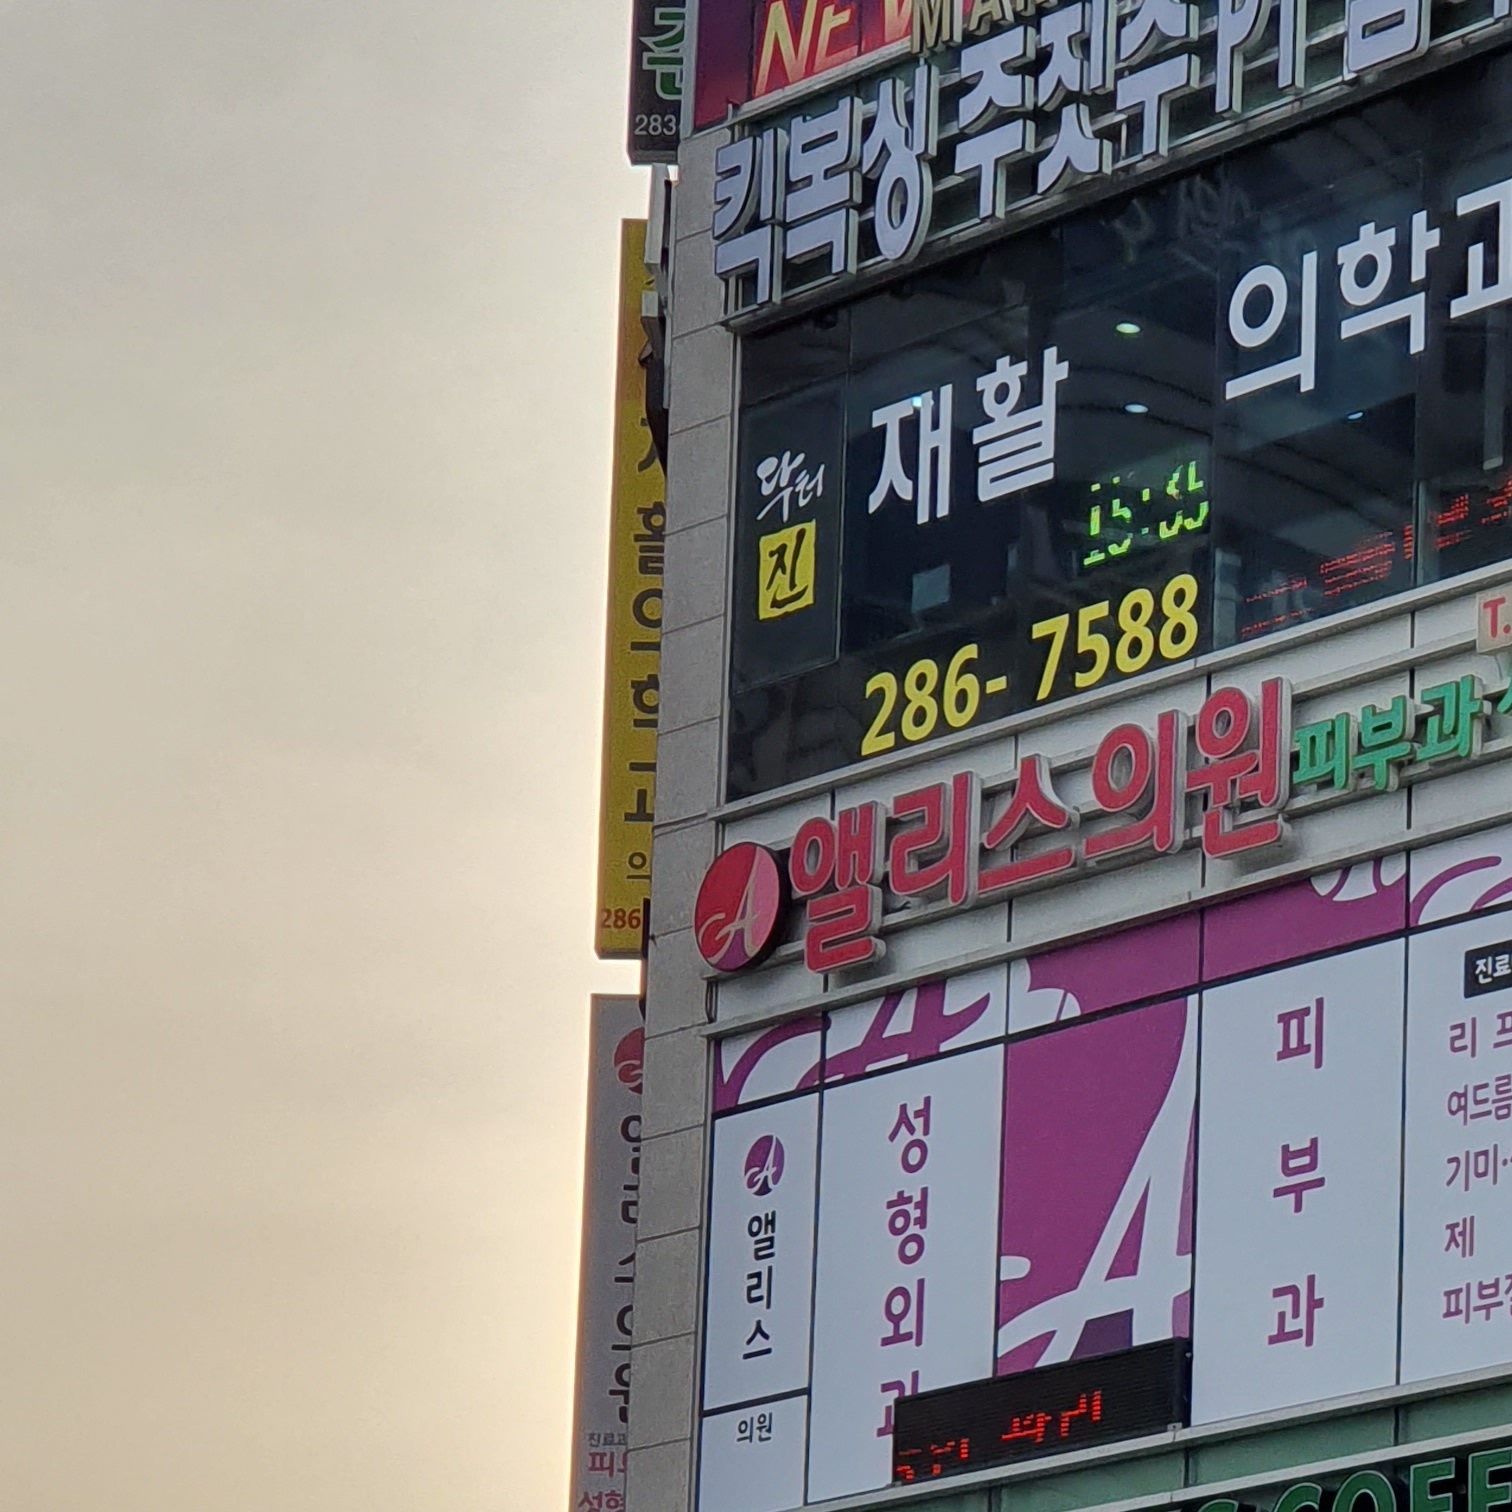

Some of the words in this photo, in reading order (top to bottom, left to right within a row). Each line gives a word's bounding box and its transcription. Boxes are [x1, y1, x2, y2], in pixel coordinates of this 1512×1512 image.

[868, 345, 1070, 526] 재활
[789, 675, 1292, 975] 앨리스의원
[1292, 673, 1488, 792] 피부과
[1266, 996, 1326, 1348] 피부과
[741, 1209, 778, 1361] 앨리스
[735, 1411, 774, 1444] 의원
